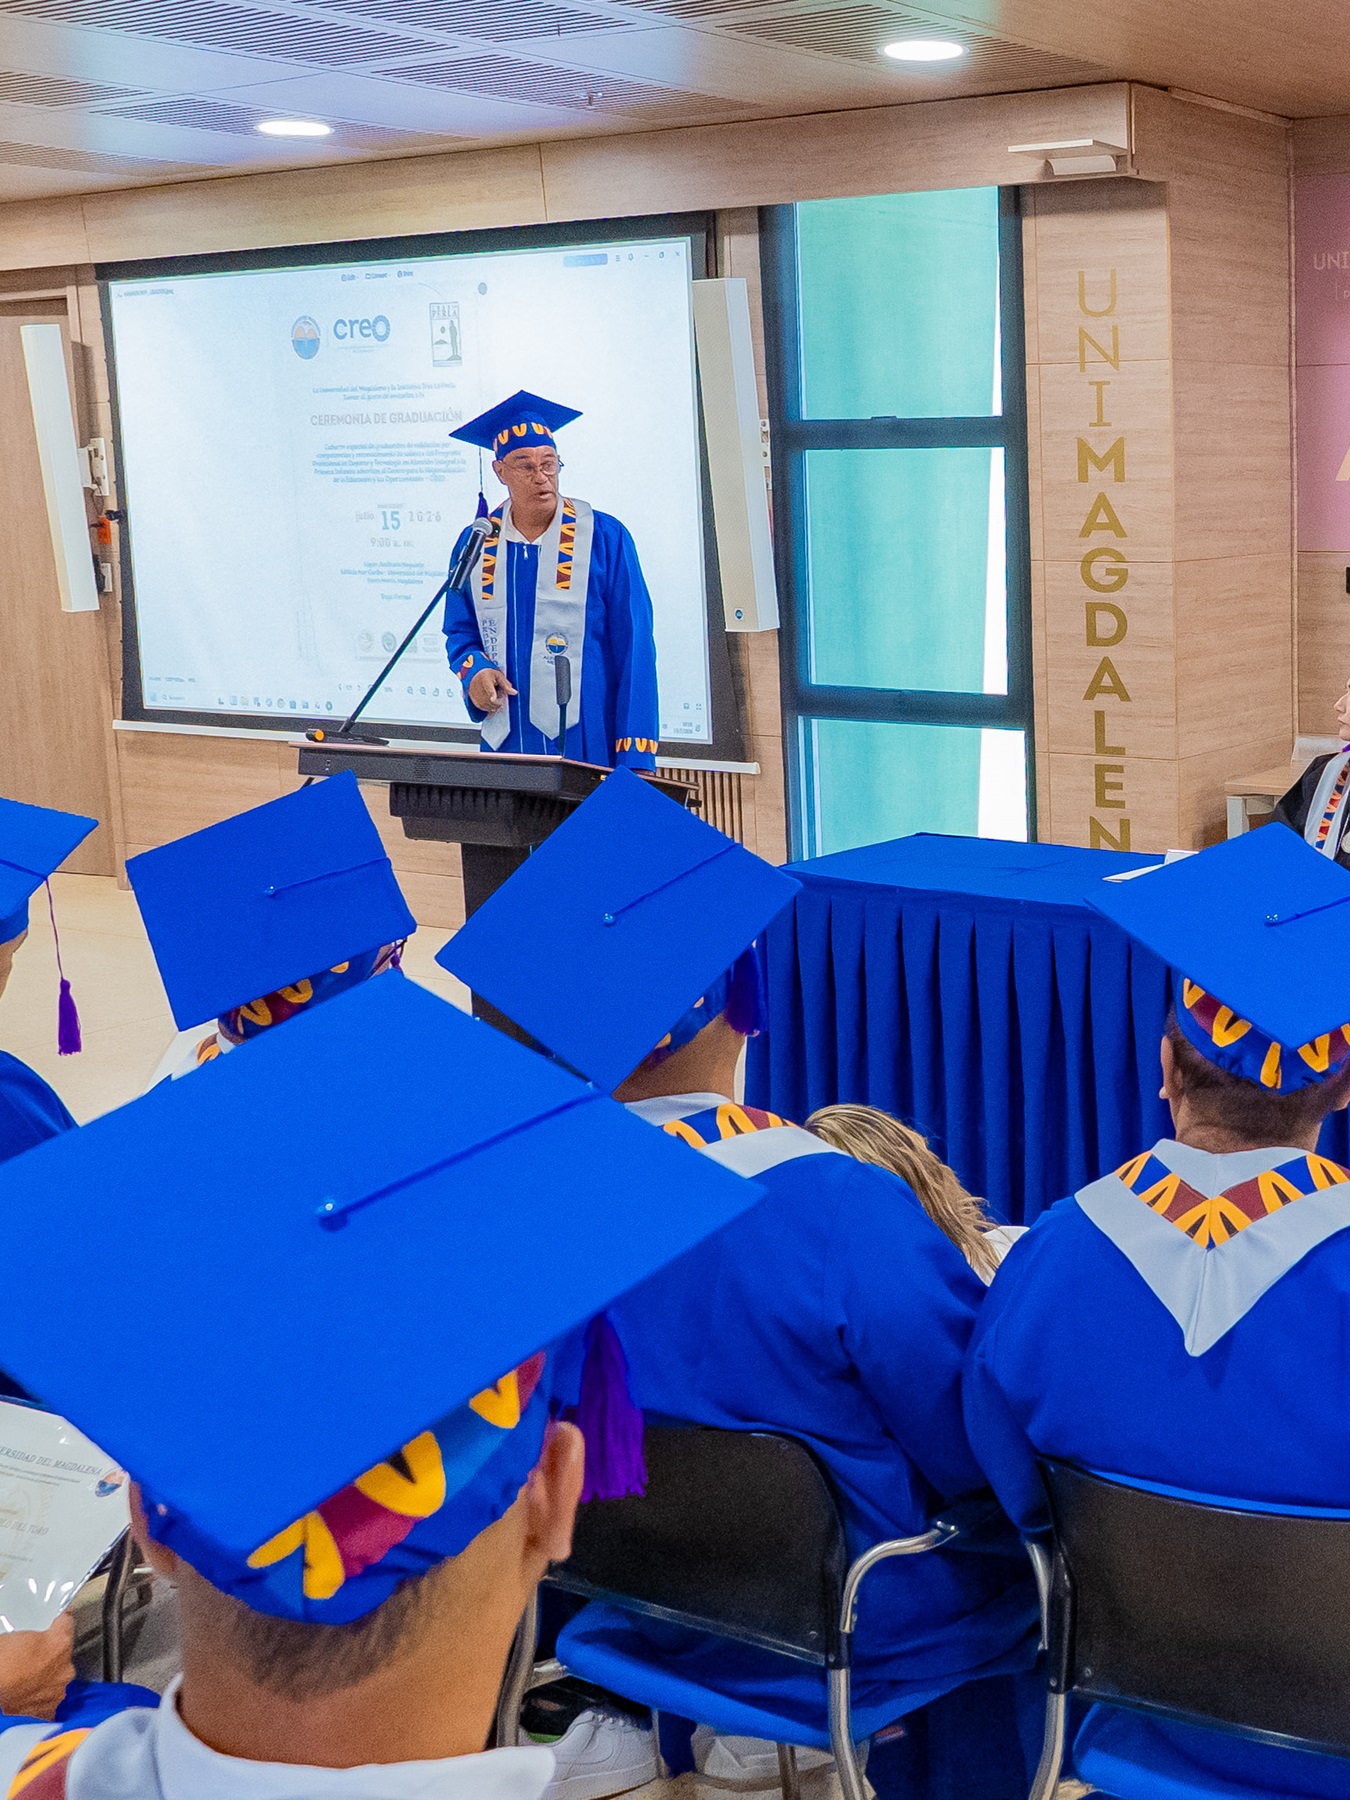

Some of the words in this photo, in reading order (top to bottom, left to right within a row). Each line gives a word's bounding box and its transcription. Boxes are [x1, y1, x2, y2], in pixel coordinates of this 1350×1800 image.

[310, 414, 372, 426] CEREMONIA
[373, 413, 387, 424] DE
[389, 407, 463, 424] GRADUACIÓN
[381, 510, 401, 530] 15
[1076, 267, 1132, 852] UNIMAGDALEN
[35, 1455, 54, 1467] DEL
[52, 1459, 104, 1477] MAGDALENA
